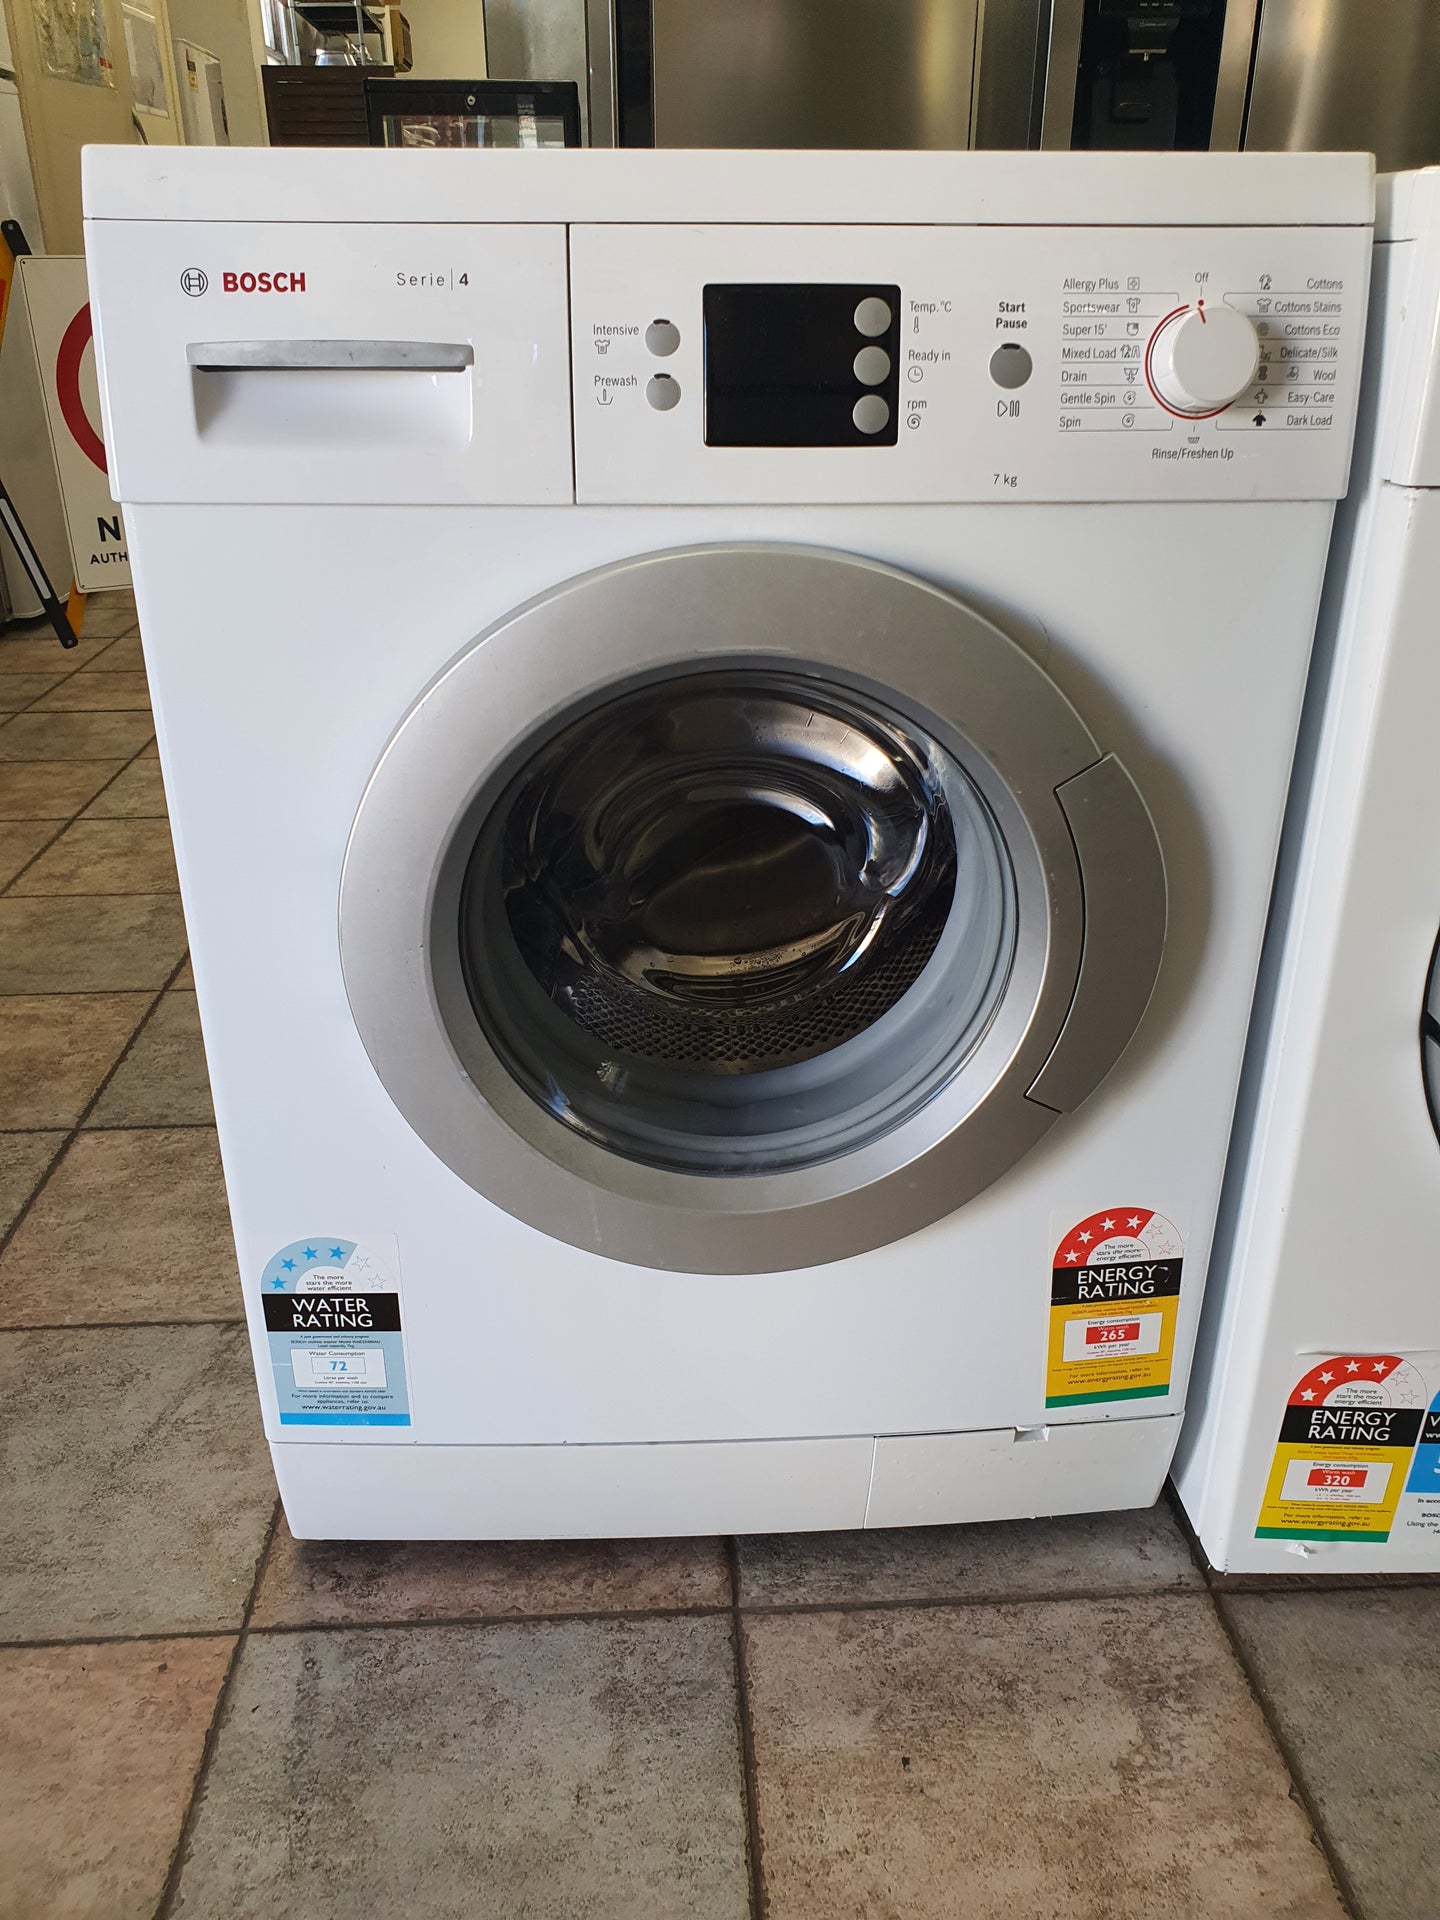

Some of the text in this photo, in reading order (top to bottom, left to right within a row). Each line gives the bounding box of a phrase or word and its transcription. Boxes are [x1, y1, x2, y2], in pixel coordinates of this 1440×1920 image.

[223, 272, 306, 292] BOSCH
[396, 272, 469, 286] Serie 4
[1194, 272, 1209, 283] Off
[1062, 278, 1120, 292] Allergy Plus
[1306, 278, 1344, 290] Cottons
[998, 302, 1026, 313] Start
[1062, 301, 1120, 314] Sportswear
[1274, 301, 1342, 313] Cottons Stains
[996, 318, 1028, 328] Pause
[593, 324, 640, 336] Intensive
[1062, 324, 1092, 336] Super
[1284, 324, 1340, 336] Cottons Eco
[908, 350, 951, 364] Ready in
[1062, 347, 1117, 359] Mixed Load
[1280, 346, 1338, 360] Delicate/Silk
[594, 374, 638, 386] Prewash
[1061, 370, 1088, 382] Drain
[1312, 369, 1336, 380] Wool
[1060, 393, 1116, 406] Gentle Spin
[907, 400, 928, 412] rpm
[1059, 416, 1082, 430] Spin
[1286, 414, 1333, 426] Dark Load
[1152, 448, 1234, 460] Rinse/Freshen Up
[993, 473, 1018, 488] 7 kg
[1077, 1264, 1158, 1284] ENERGY
[1078, 1280, 1155, 1300] RATING
[291, 1298, 369, 1312] WATER
[292, 1314, 373, 1328] RATING
[1100, 1330, 1126, 1341] 265
[330, 1361, 347, 1371] 72
[1067, 1372, 1152, 1385] www.energyrating.gov.au
[1311, 1410, 1398, 1426] ENERGY
[1308, 1425, 1391, 1441] RATING
[1323, 1475, 1350, 1486] 320
[1280, 1519, 1370, 1527] www.energyrating.gov.au
